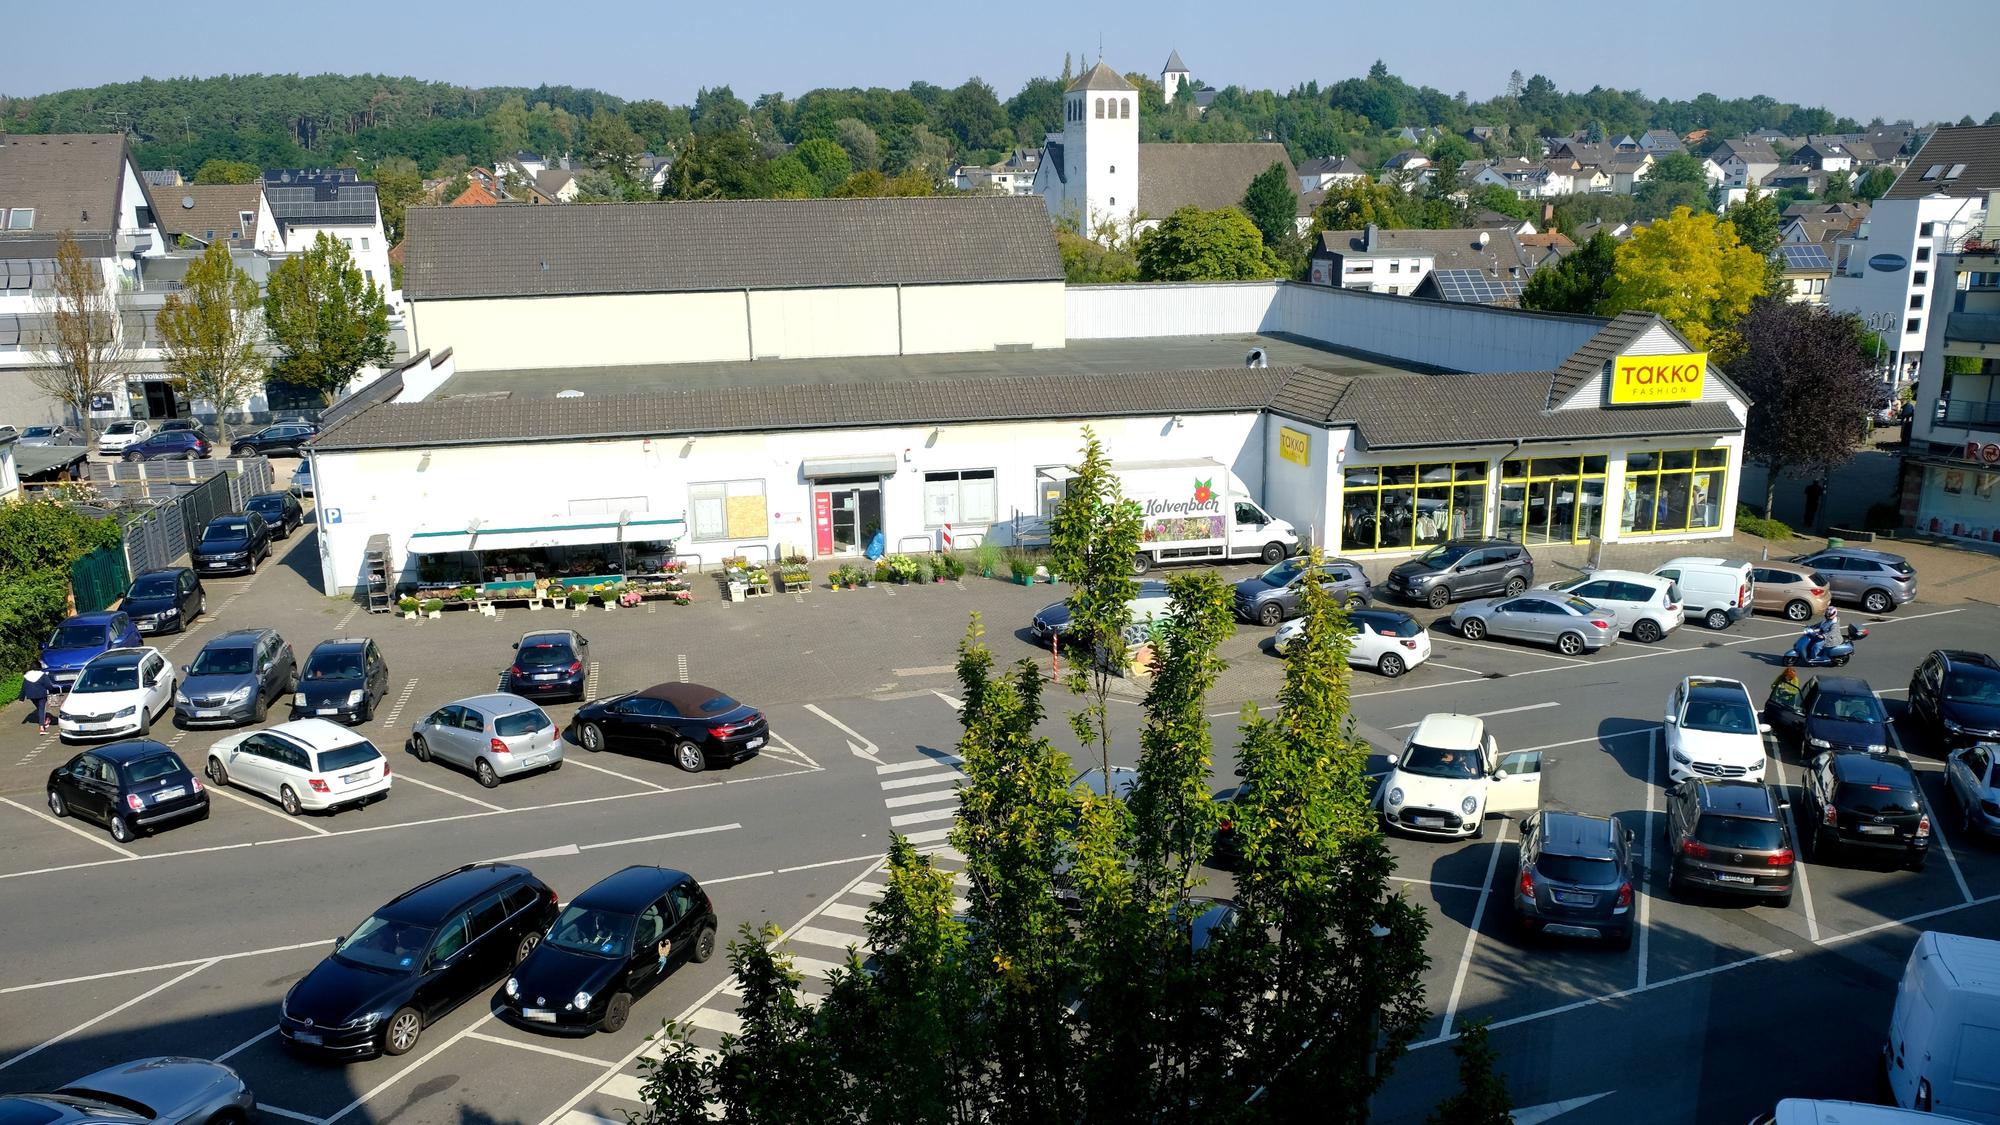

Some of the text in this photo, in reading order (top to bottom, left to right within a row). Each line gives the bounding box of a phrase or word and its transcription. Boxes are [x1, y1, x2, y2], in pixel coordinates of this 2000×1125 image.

[1632, 386, 1687, 396] FASHION
[1145, 497, 1219, 517] Kolvenbach
[327, 508, 340, 524] P
